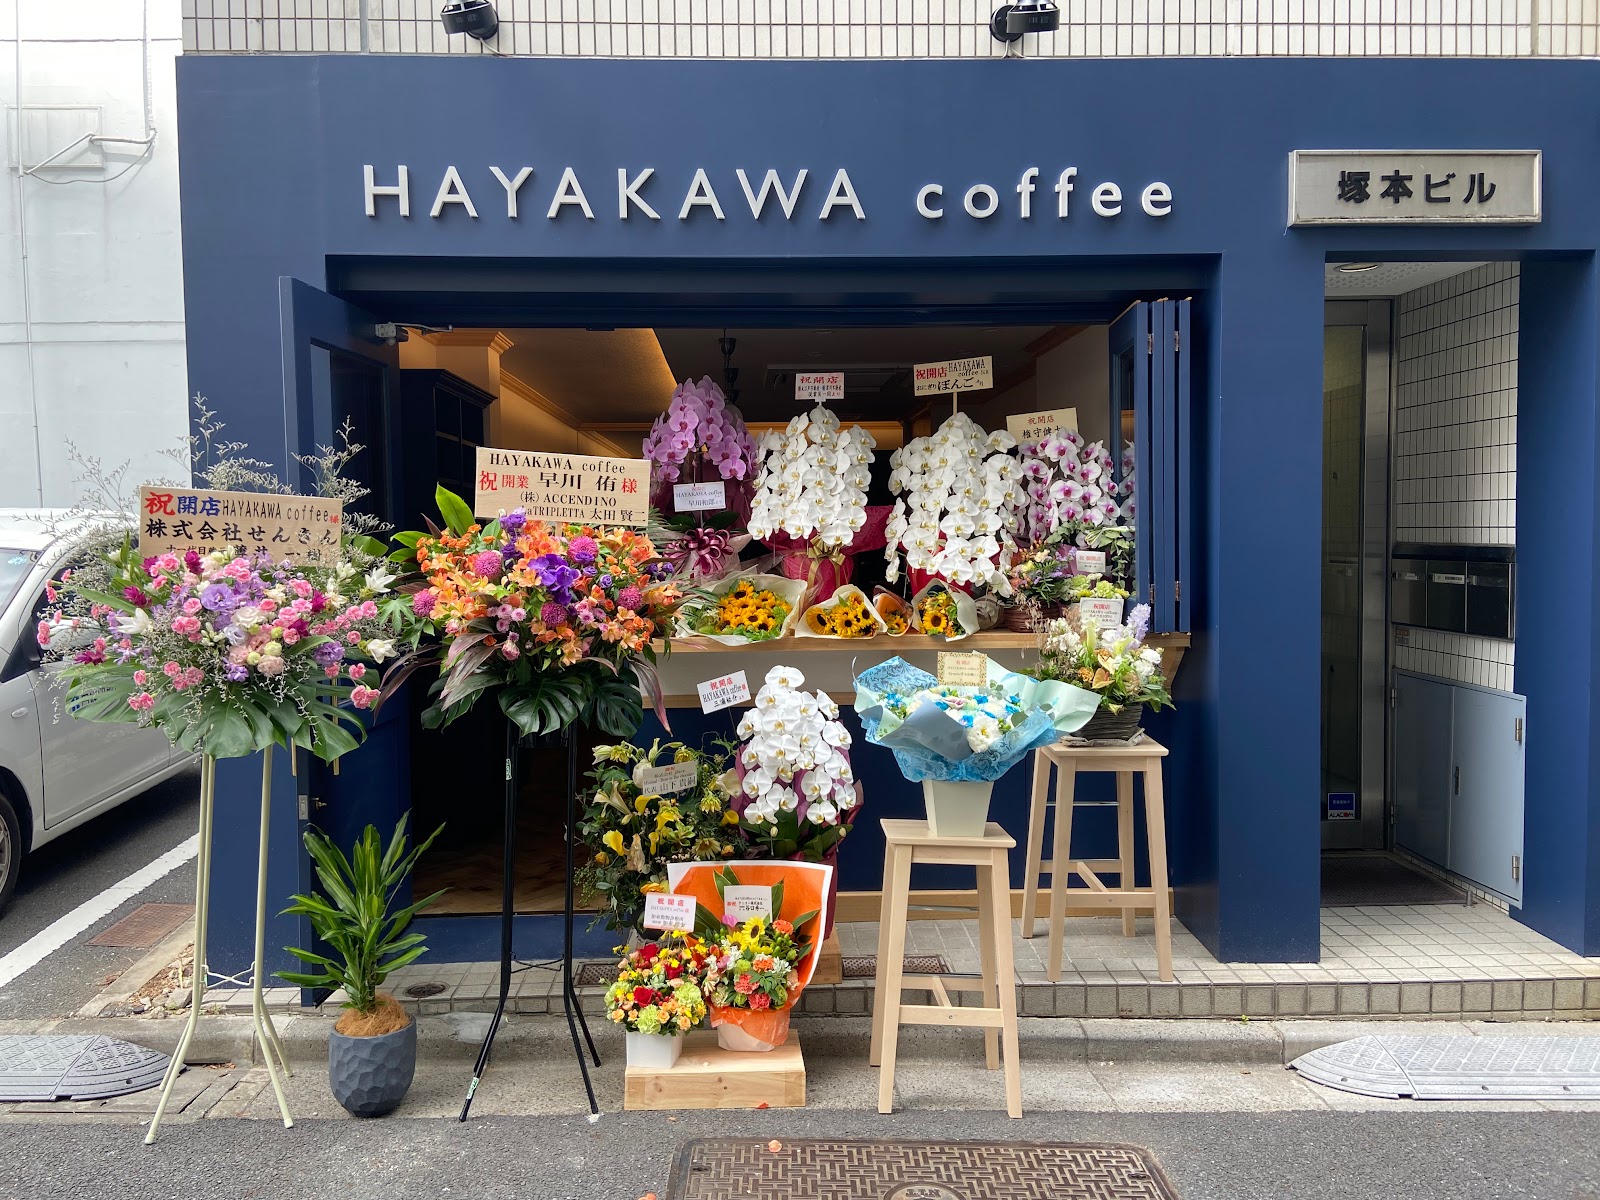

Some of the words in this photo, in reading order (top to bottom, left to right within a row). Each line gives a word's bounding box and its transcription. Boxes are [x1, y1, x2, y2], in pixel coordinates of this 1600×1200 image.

[363, 165, 866, 220] HAYAKAWA
[916, 167, 1173, 219] coffee
[1338, 169, 1497, 205] 塚本ビル
[948, 359, 986, 373] HAYAKAWA
[1028, 414, 1055, 425] 祝開店
[490, 453, 573, 470] HAYAKAWA
[582, 461, 626, 474] coffee
[479, 470, 498, 491] 祝
[501, 474, 529, 489] 開業
[537, 472, 582, 490] 早川
[595, 475, 618, 492] 侑
[621, 478, 638, 494] 様
[144, 492, 222, 516] 祝開店
[222, 499, 282, 520] HAYAKAWA
[286, 504, 329, 522] coffee
[543, 493, 617, 507] ACCENDINO
[590, 508, 616, 521] 太田
[620, 509, 646, 522] 賢二
[702, 687, 730, 703] HAYAKAWA
